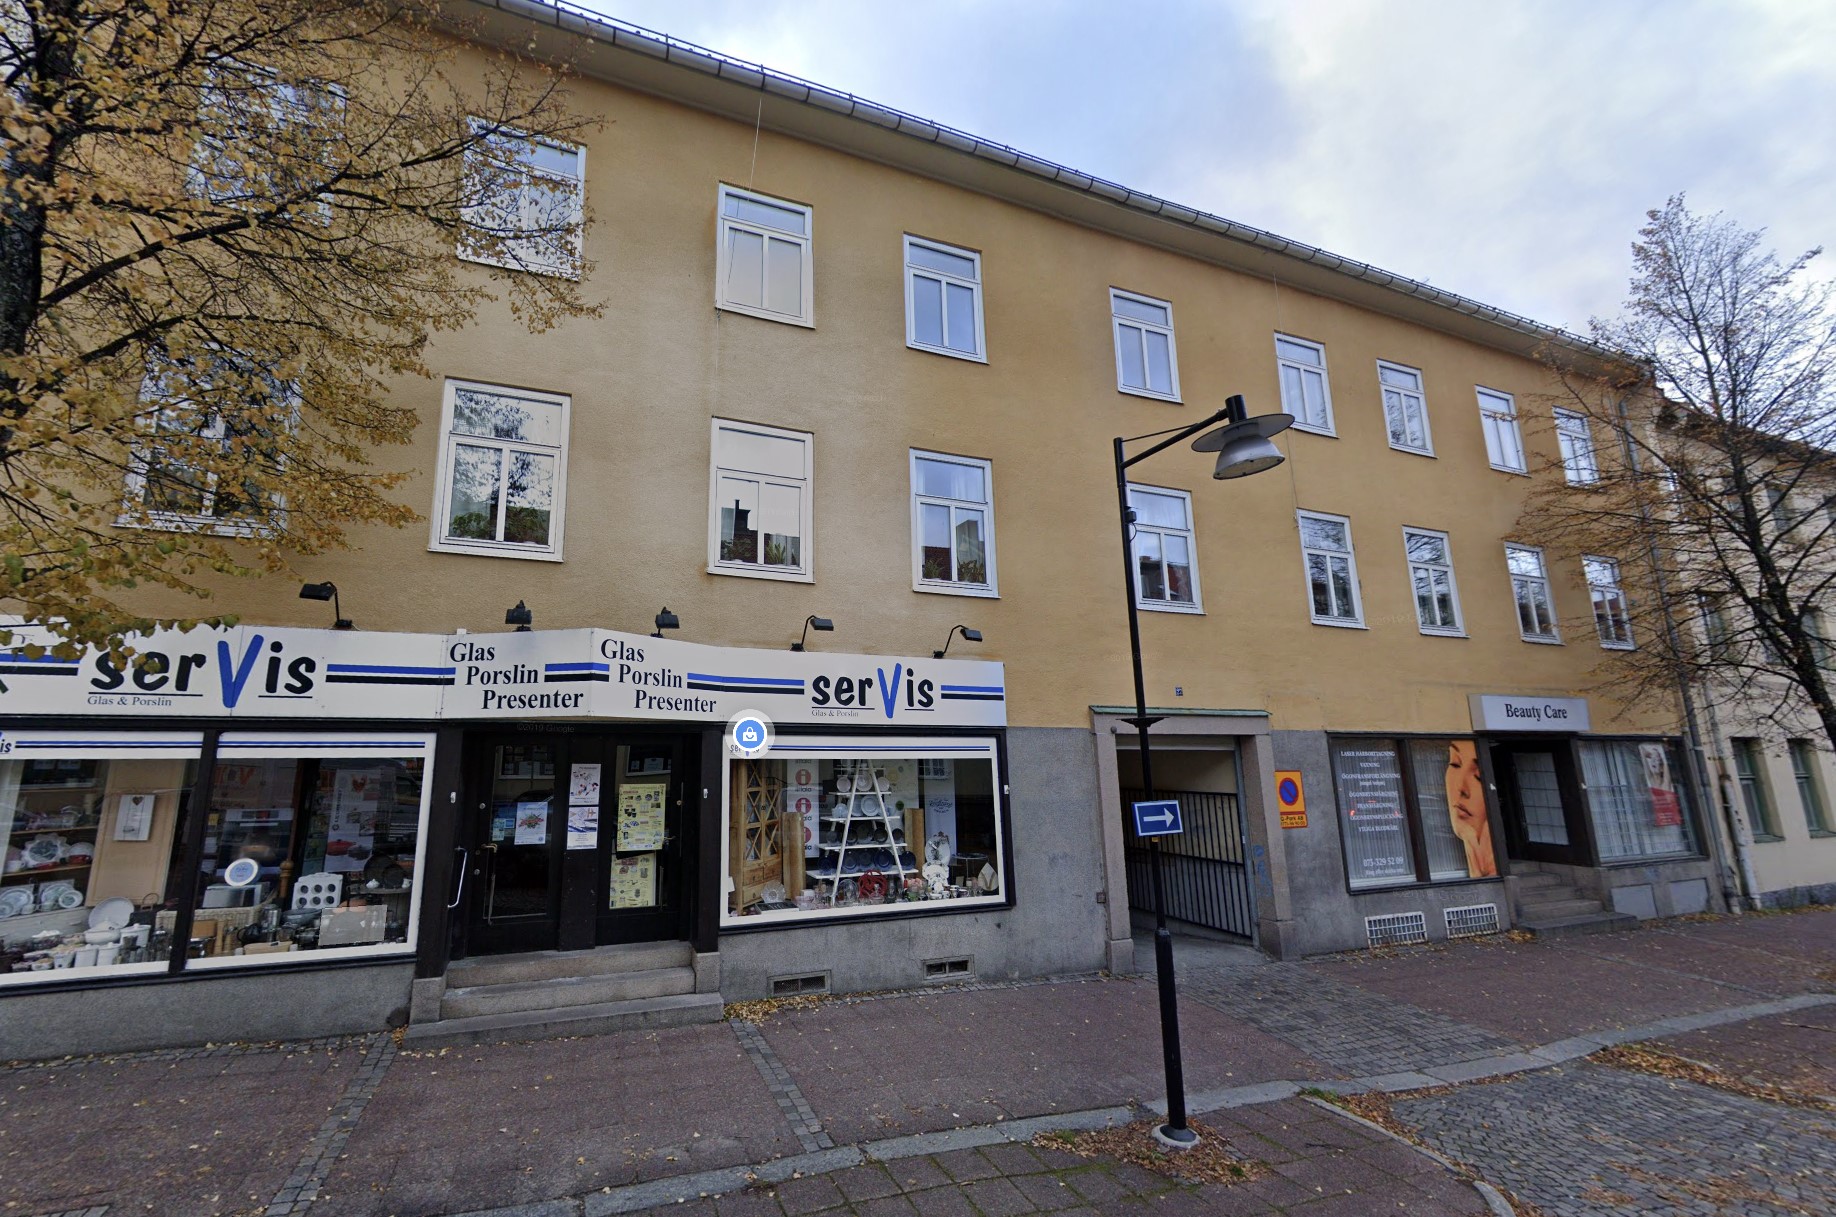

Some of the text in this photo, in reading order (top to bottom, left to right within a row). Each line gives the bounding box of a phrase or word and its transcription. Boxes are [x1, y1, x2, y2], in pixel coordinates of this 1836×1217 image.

[449, 642, 495, 663] Glas
[601, 638, 645, 663] Glas
[465, 664, 539, 686] Porslin
[619, 663, 683, 690] Porslin
[88, 695, 172, 707] Glas & Porslin
[482, 689, 584, 710] Presenter
[812, 662, 934, 719] serVis
[634, 690, 717, 713] Presenter
[811, 709, 827, 717] Glas
[1504, 703, 1568, 722] Beauty Care
